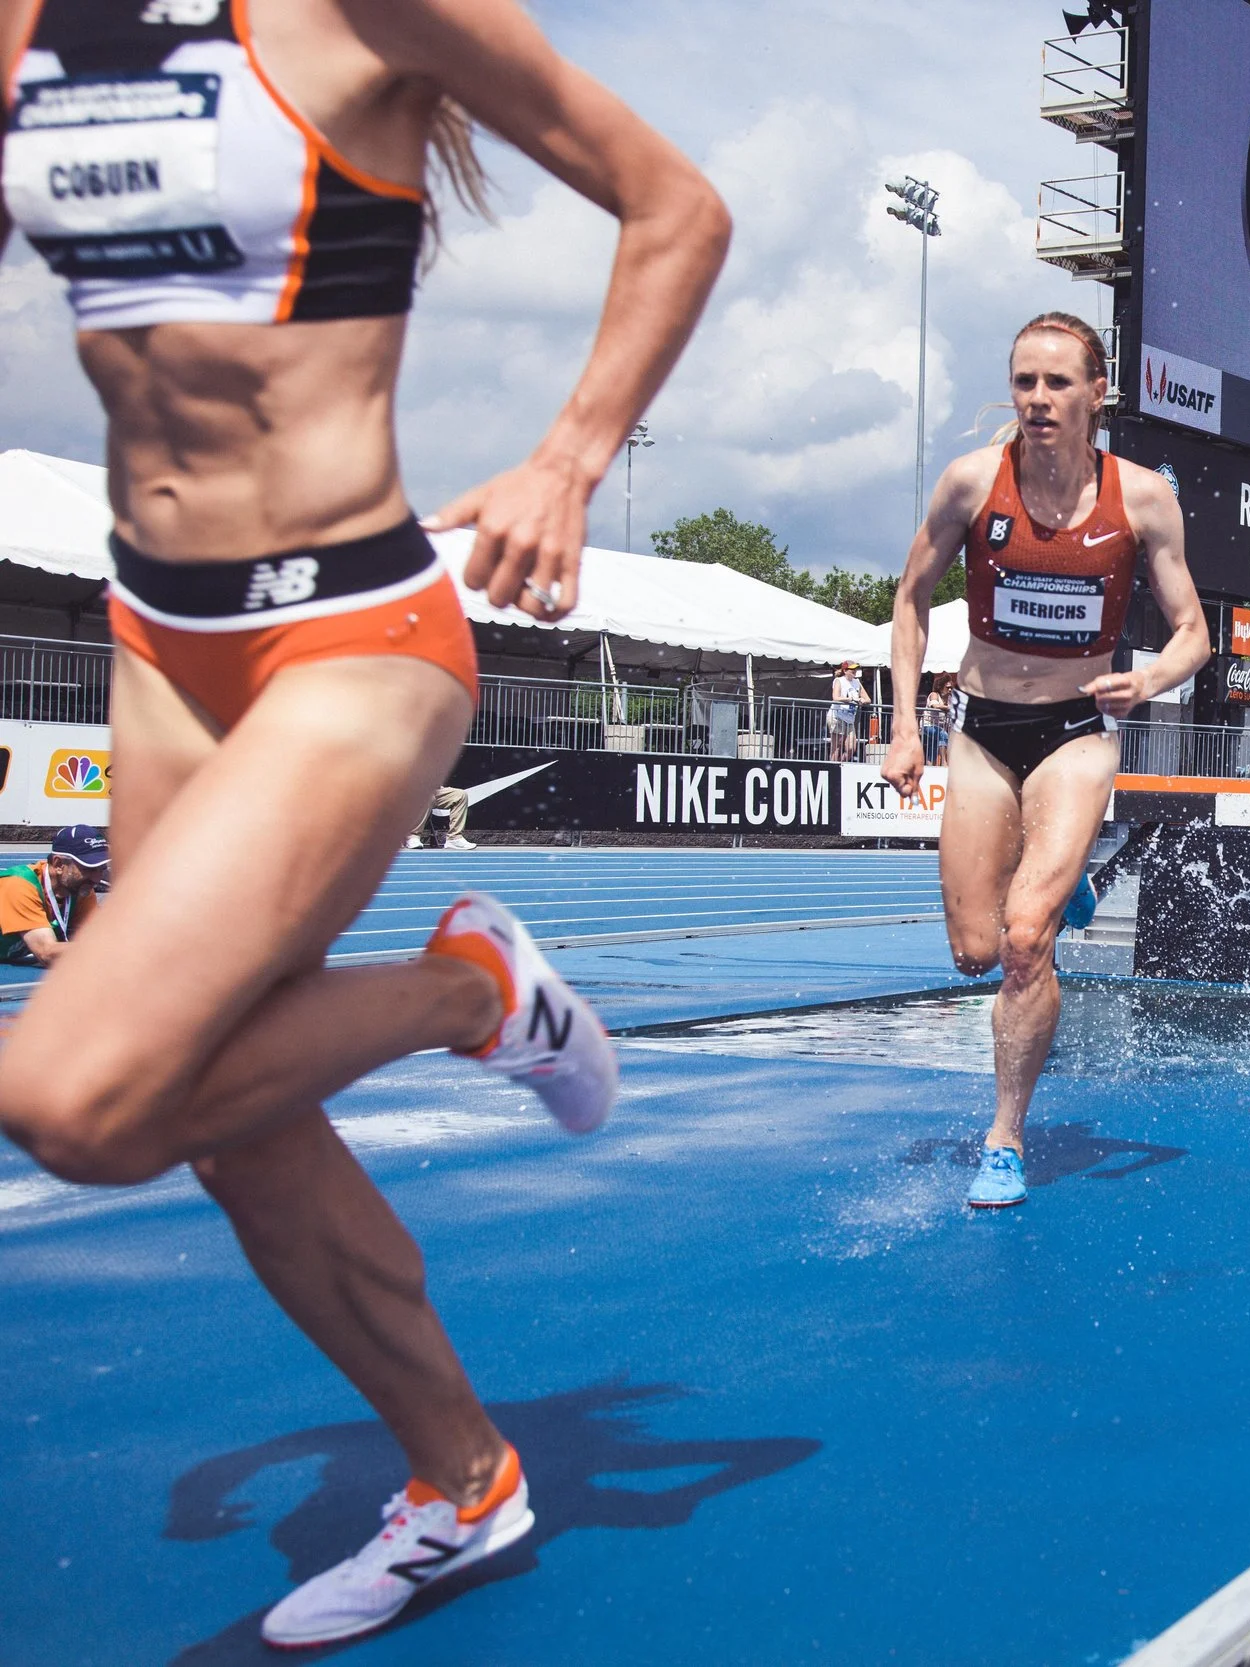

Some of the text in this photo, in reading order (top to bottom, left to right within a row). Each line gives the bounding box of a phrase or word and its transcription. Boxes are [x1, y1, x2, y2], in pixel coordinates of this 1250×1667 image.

[48, 158, 161, 200] COBURN
[1167, 381, 1216, 414] USATF
[1003, 578, 1097, 594] CHAMPIONSHIPS
[1054, 577, 1086, 585] OUTDOOR
[1010, 598, 1087, 620] FRERICHS
[636, 763, 829, 825] NIKE.COM
[856, 782, 890, 809] KT
[856, 812, 898, 820] KINESIOLOGY
